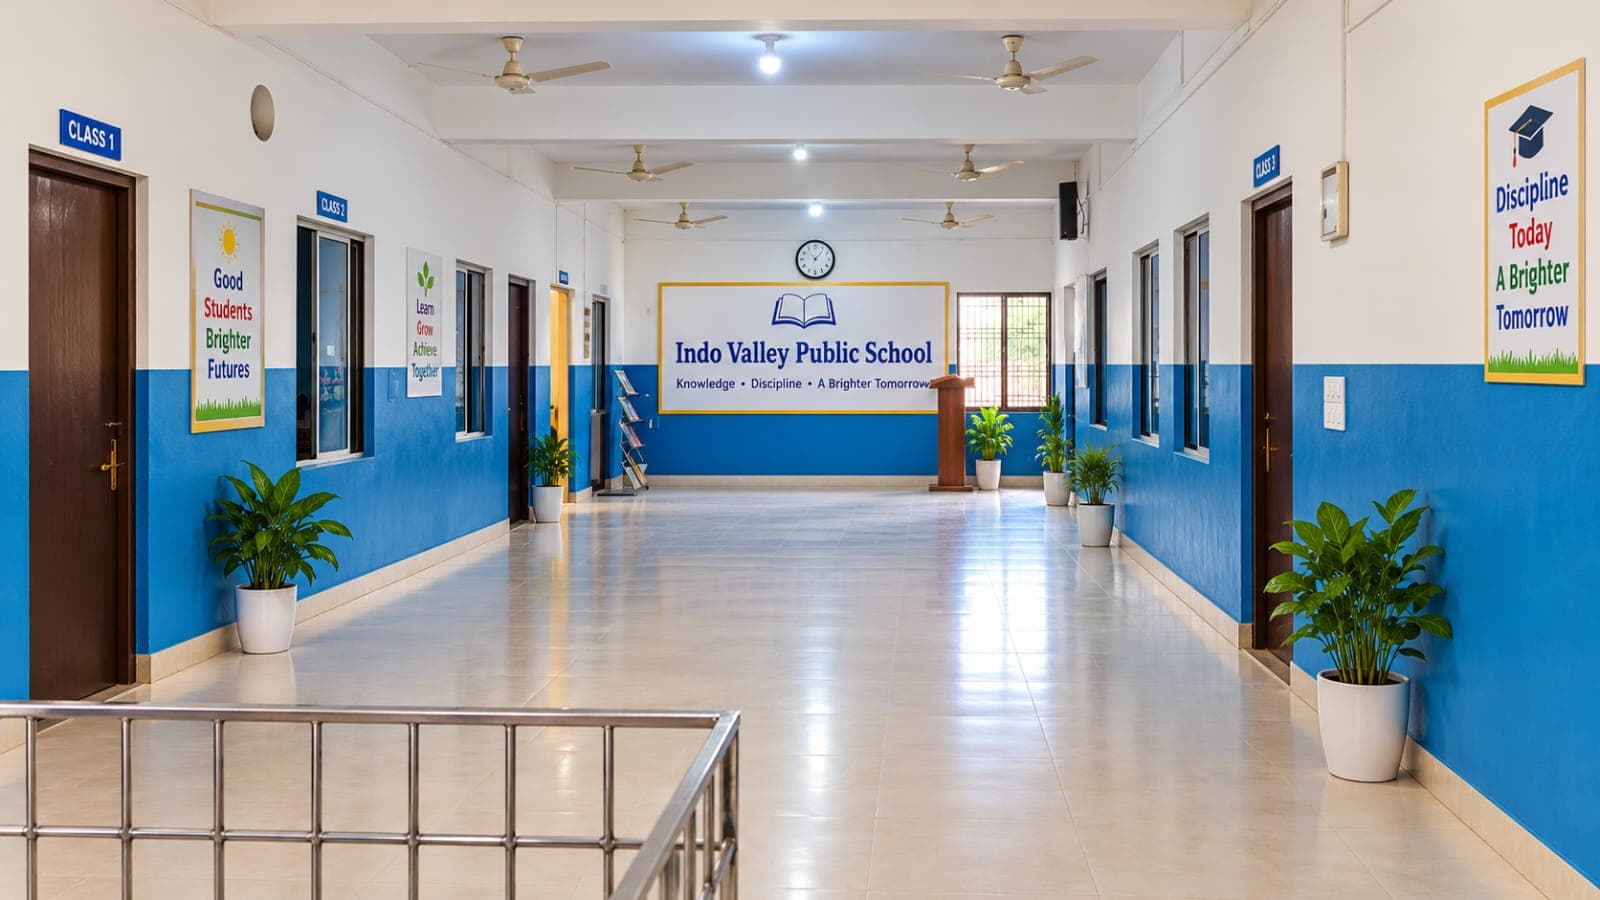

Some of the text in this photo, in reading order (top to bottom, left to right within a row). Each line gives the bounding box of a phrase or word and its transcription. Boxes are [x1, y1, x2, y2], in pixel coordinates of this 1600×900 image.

[69, 120, 114, 151] CLASS 1
[1256, 154, 1275, 179] CLASS 3
[1496, 171, 1568, 213] Discipline
[322, 198, 345, 216] CLASS 2
[1509, 217, 1552, 250] Today
[214, 268, 243, 291] Good
[1496, 257, 1569, 295] A Brighter
[204, 297, 253, 320] Students
[416, 298, 435, 316] Learn
[1496, 304, 1569, 330] Tomorrow
[416, 320, 434, 336] Grow
[206, 327, 252, 354] Brighter
[413, 341, 437, 356] Achieve
[675, 340, 933, 370] Indo Valley Public School
[208, 358, 250, 379] Futures
[411, 362, 439, 382] Together
[676, 378, 930, 392] Knowledge Discipline A Brighter Tomorrow
